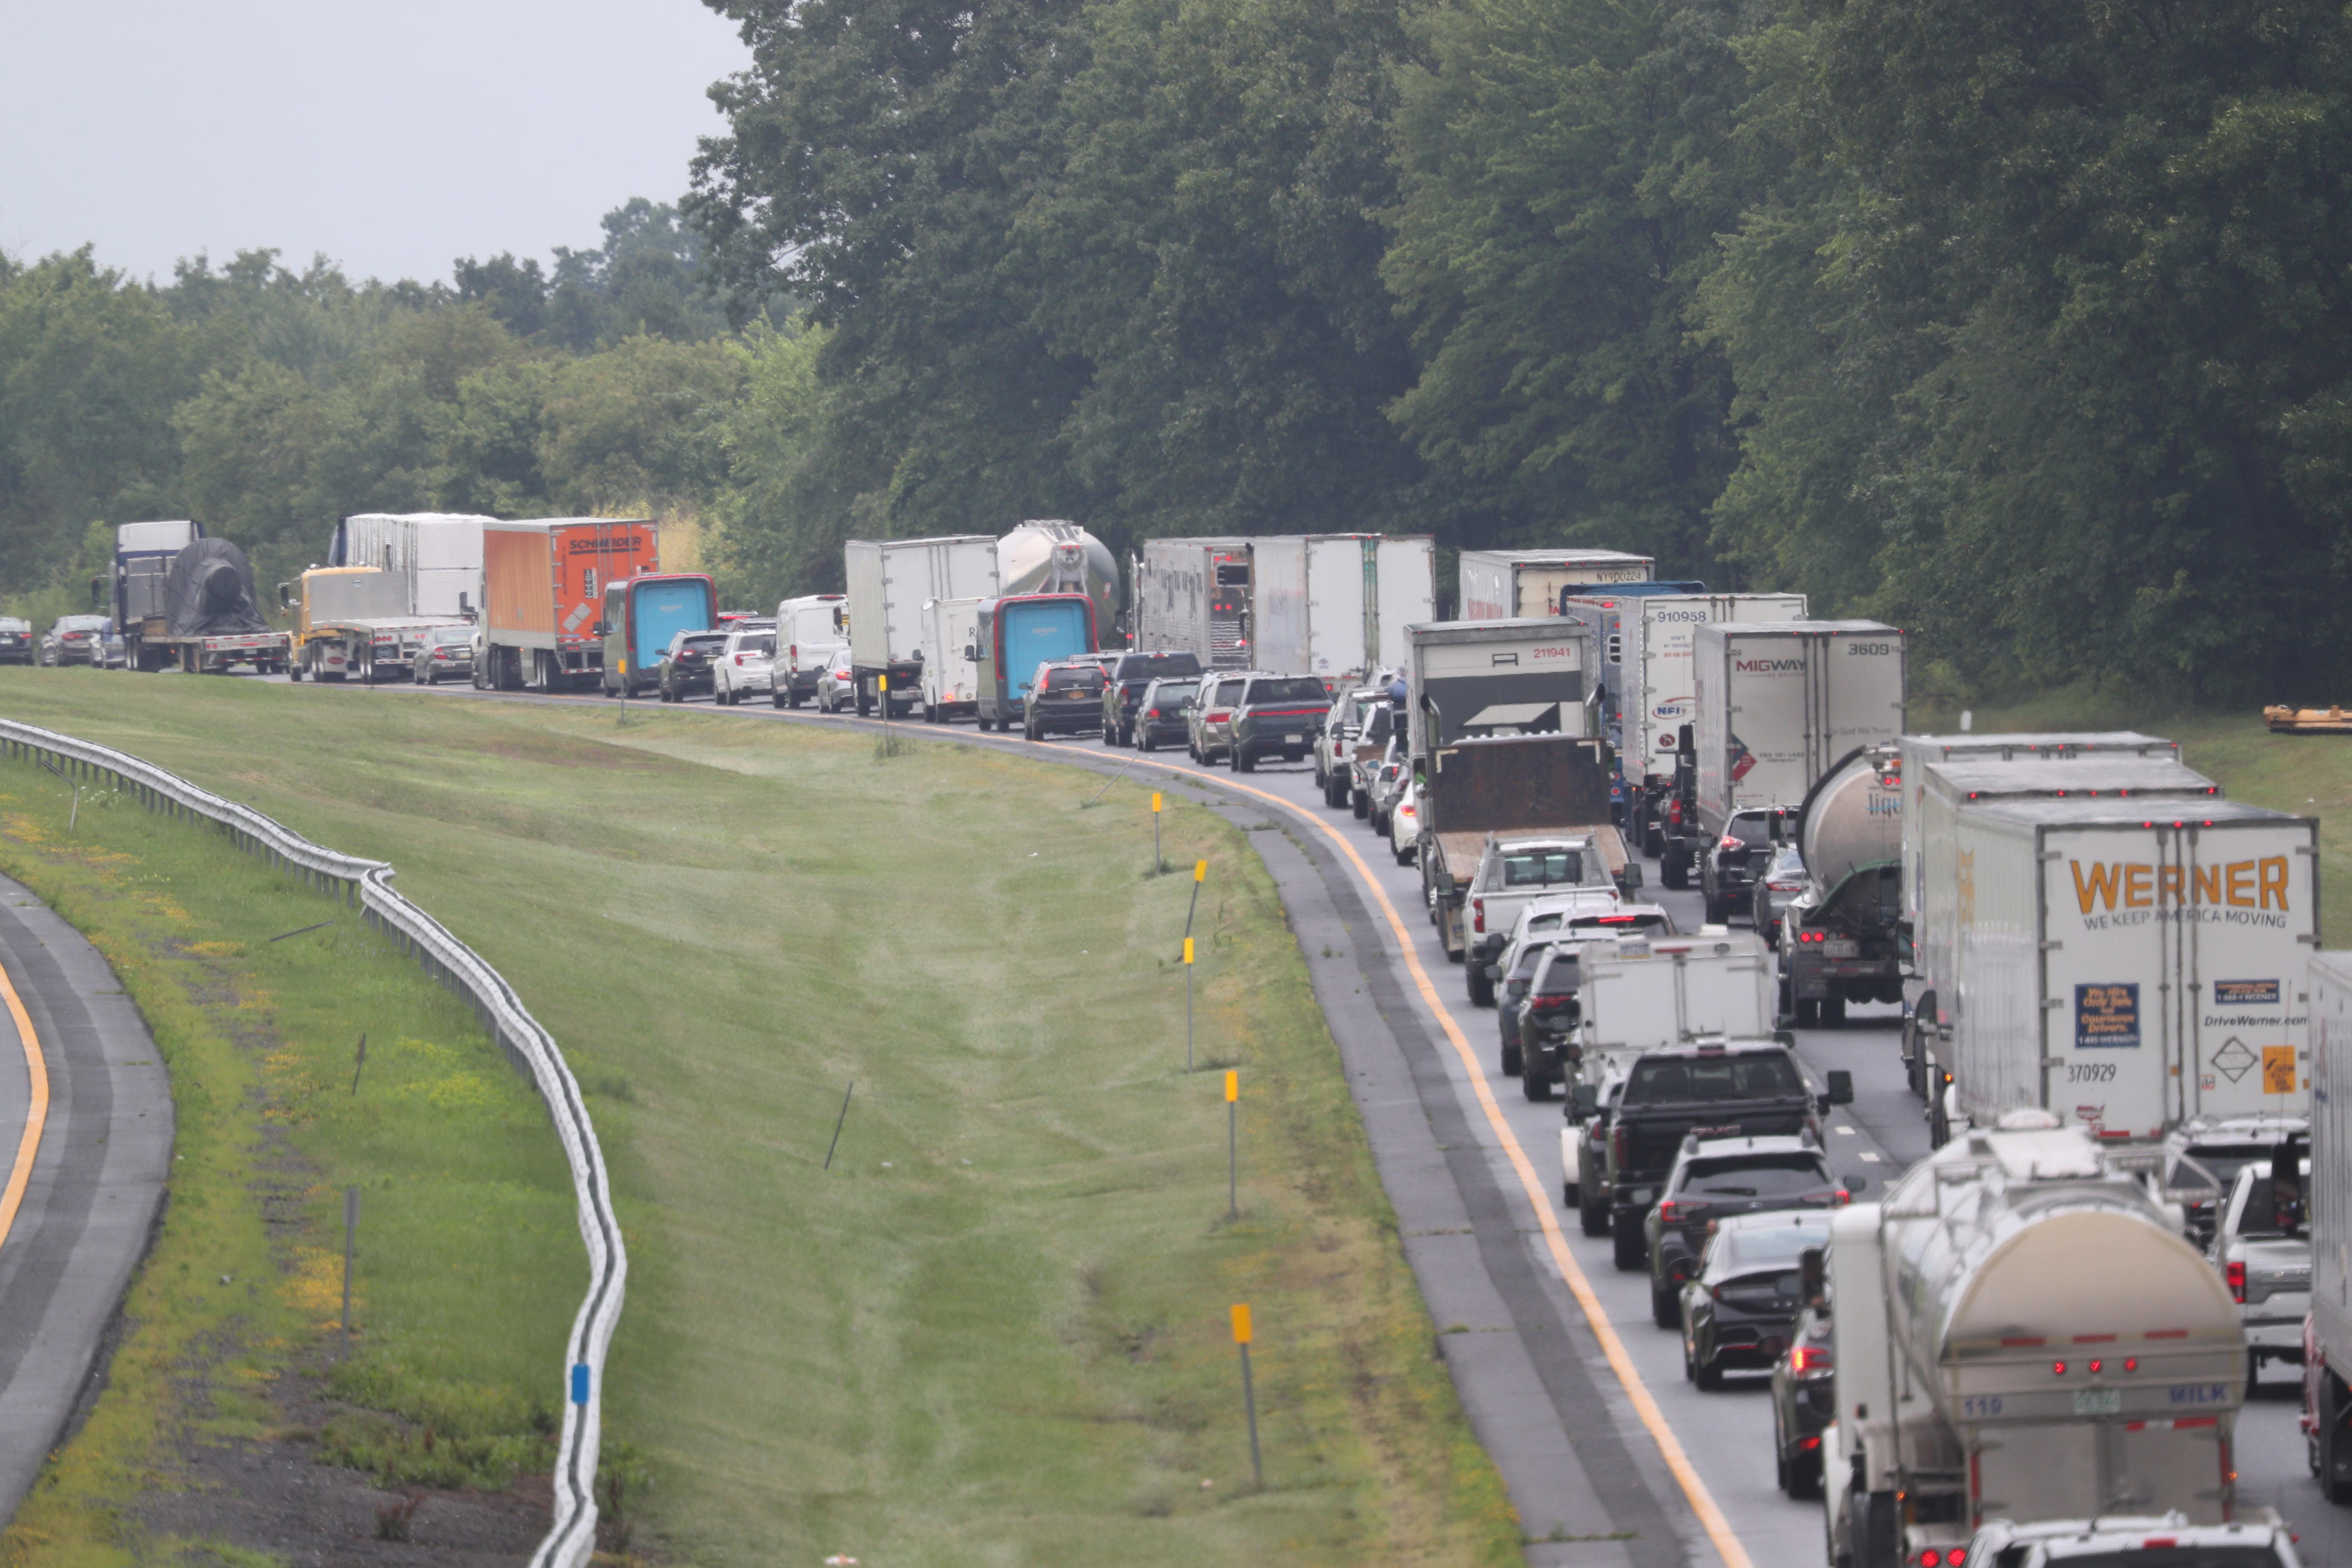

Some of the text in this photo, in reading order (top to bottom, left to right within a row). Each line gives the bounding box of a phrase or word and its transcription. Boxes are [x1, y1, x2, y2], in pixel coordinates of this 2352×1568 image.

[569, 537, 641, 549] SCHNEIDER
[1597, 572, 1641, 583] NY900224
[1657, 611, 1706, 622] 910958
[1534, 648, 1570, 659] 211941
[1848, 644, 1889, 655] 3609
[1736, 659, 1806, 672] MIGWAY
[2070, 856, 2289, 915] WERNER
[2084, 909, 2287, 931] WE KEEP AMERICA MOVING
[2068, 1064, 2117, 1083] 370929
[1690, 1125, 1741, 1136] GMC
[2170, 1383, 2227, 1403] MILK
